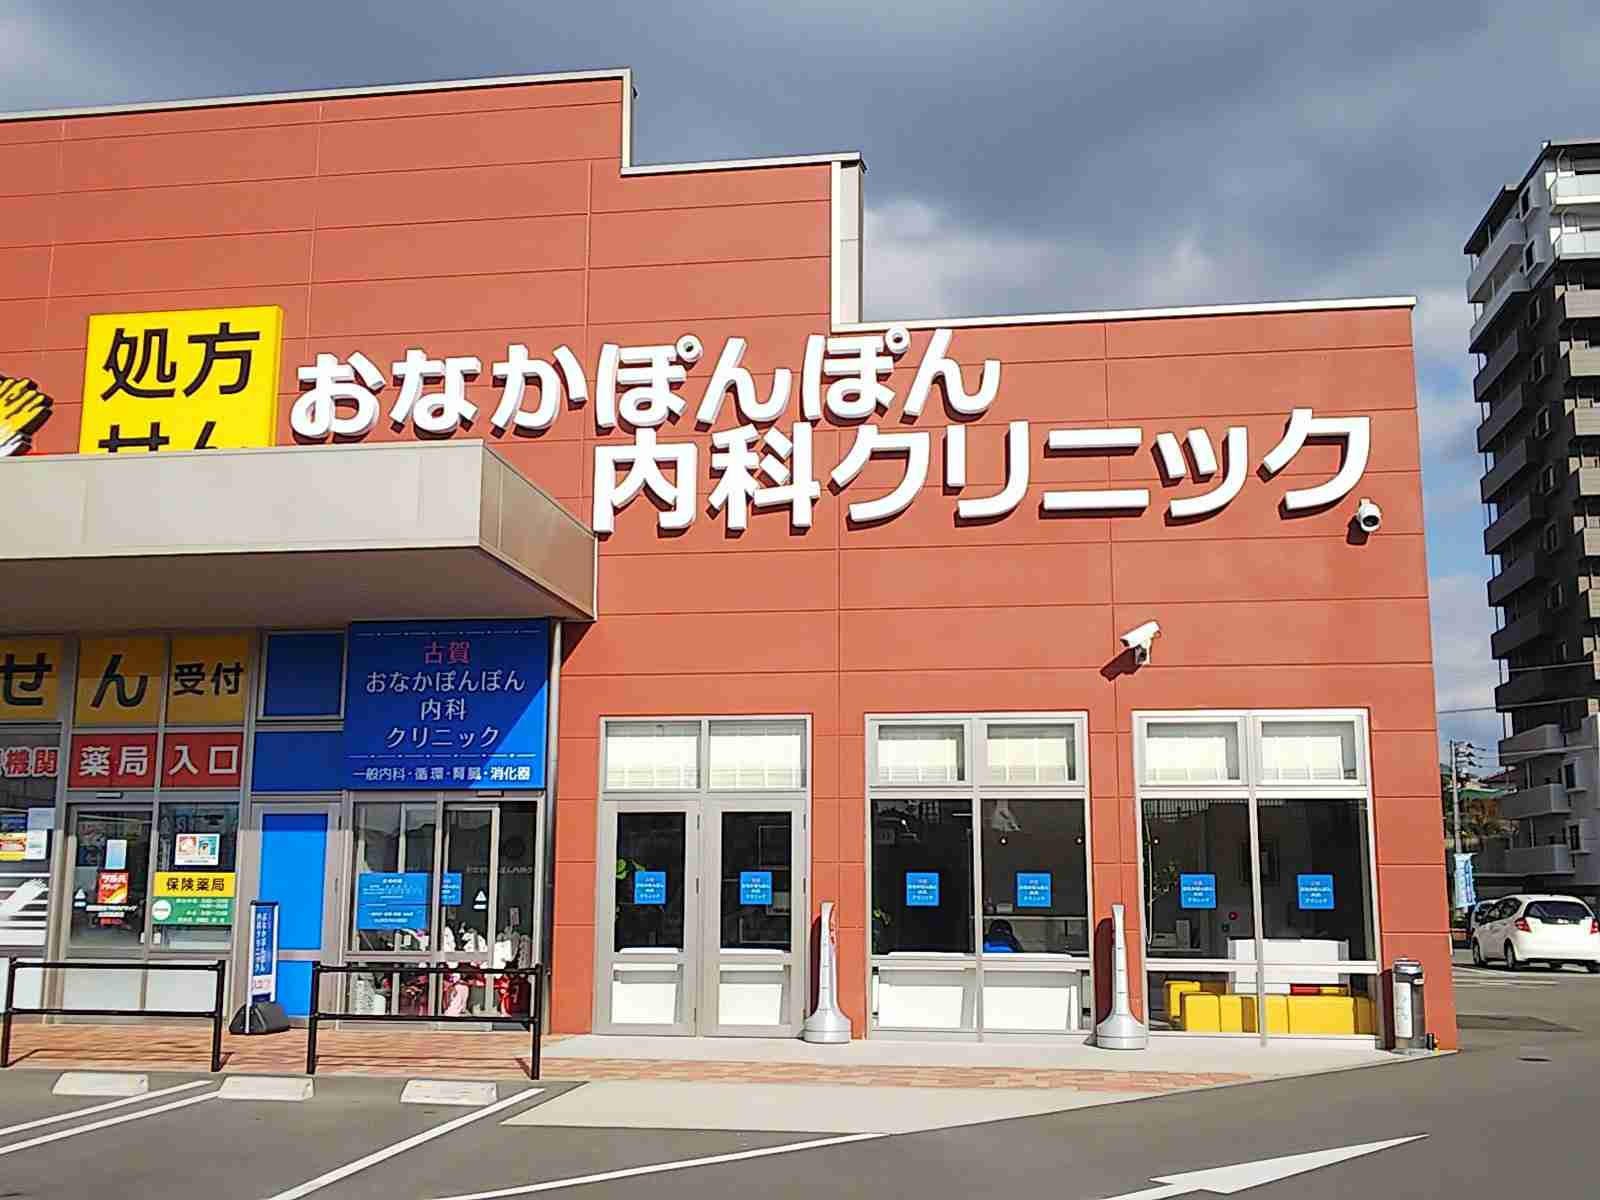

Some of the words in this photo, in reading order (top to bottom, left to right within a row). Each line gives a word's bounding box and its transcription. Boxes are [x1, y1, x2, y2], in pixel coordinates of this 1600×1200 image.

[102, 322, 260, 400] 処方
[290, 329, 1001, 438] おなかぽんぽん
[594, 408, 1371, 535] 内科クリニック
[424, 641, 470, 664] 古賀
[366, 669, 525, 693] おなかぽんぽん
[420, 698, 467, 721] 内科
[387, 726, 499, 748] クリニック
[0, 747, 60, 778] 機関
[166, 877, 225, 892] 保険薬局
